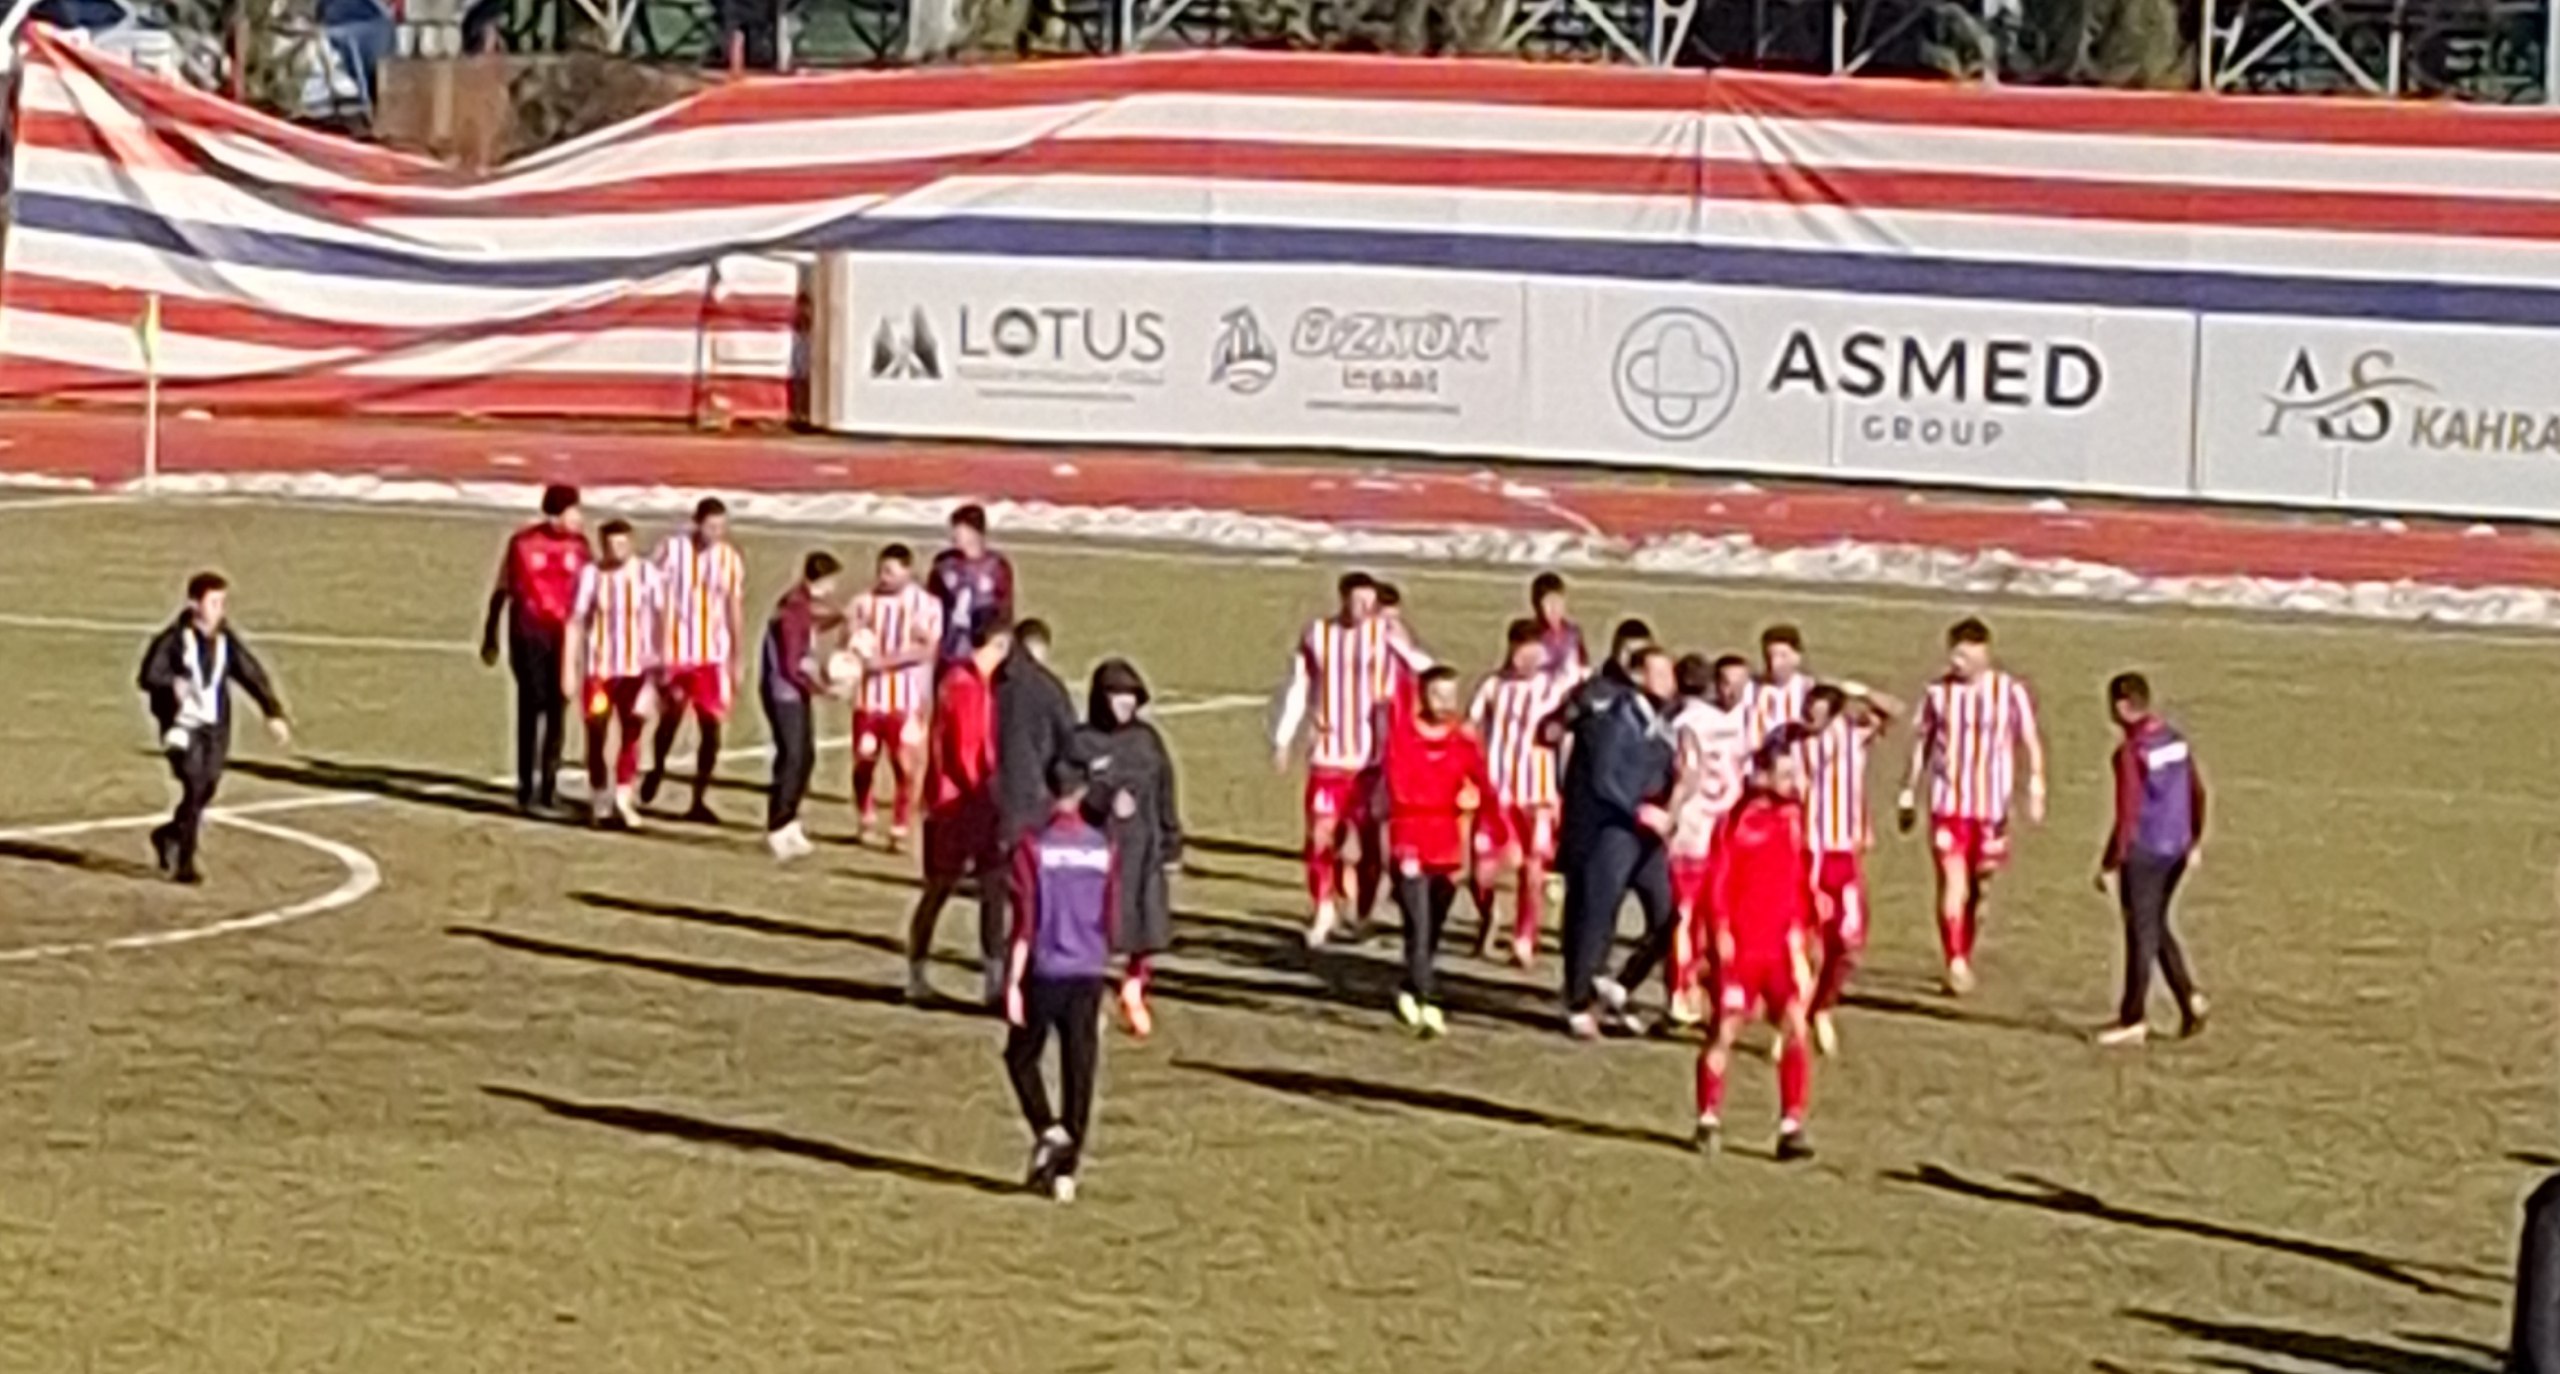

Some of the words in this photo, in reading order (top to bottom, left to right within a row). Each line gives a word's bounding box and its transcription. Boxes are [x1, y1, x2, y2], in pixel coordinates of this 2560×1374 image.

[959, 304, 1166, 362] LOTUS
[1767, 330, 2103, 408] ASMED
[2259, 345, 2396, 443] AS
[1862, 415, 2004, 446] GROUP
[2409, 405, 2560, 452] KAHRA
